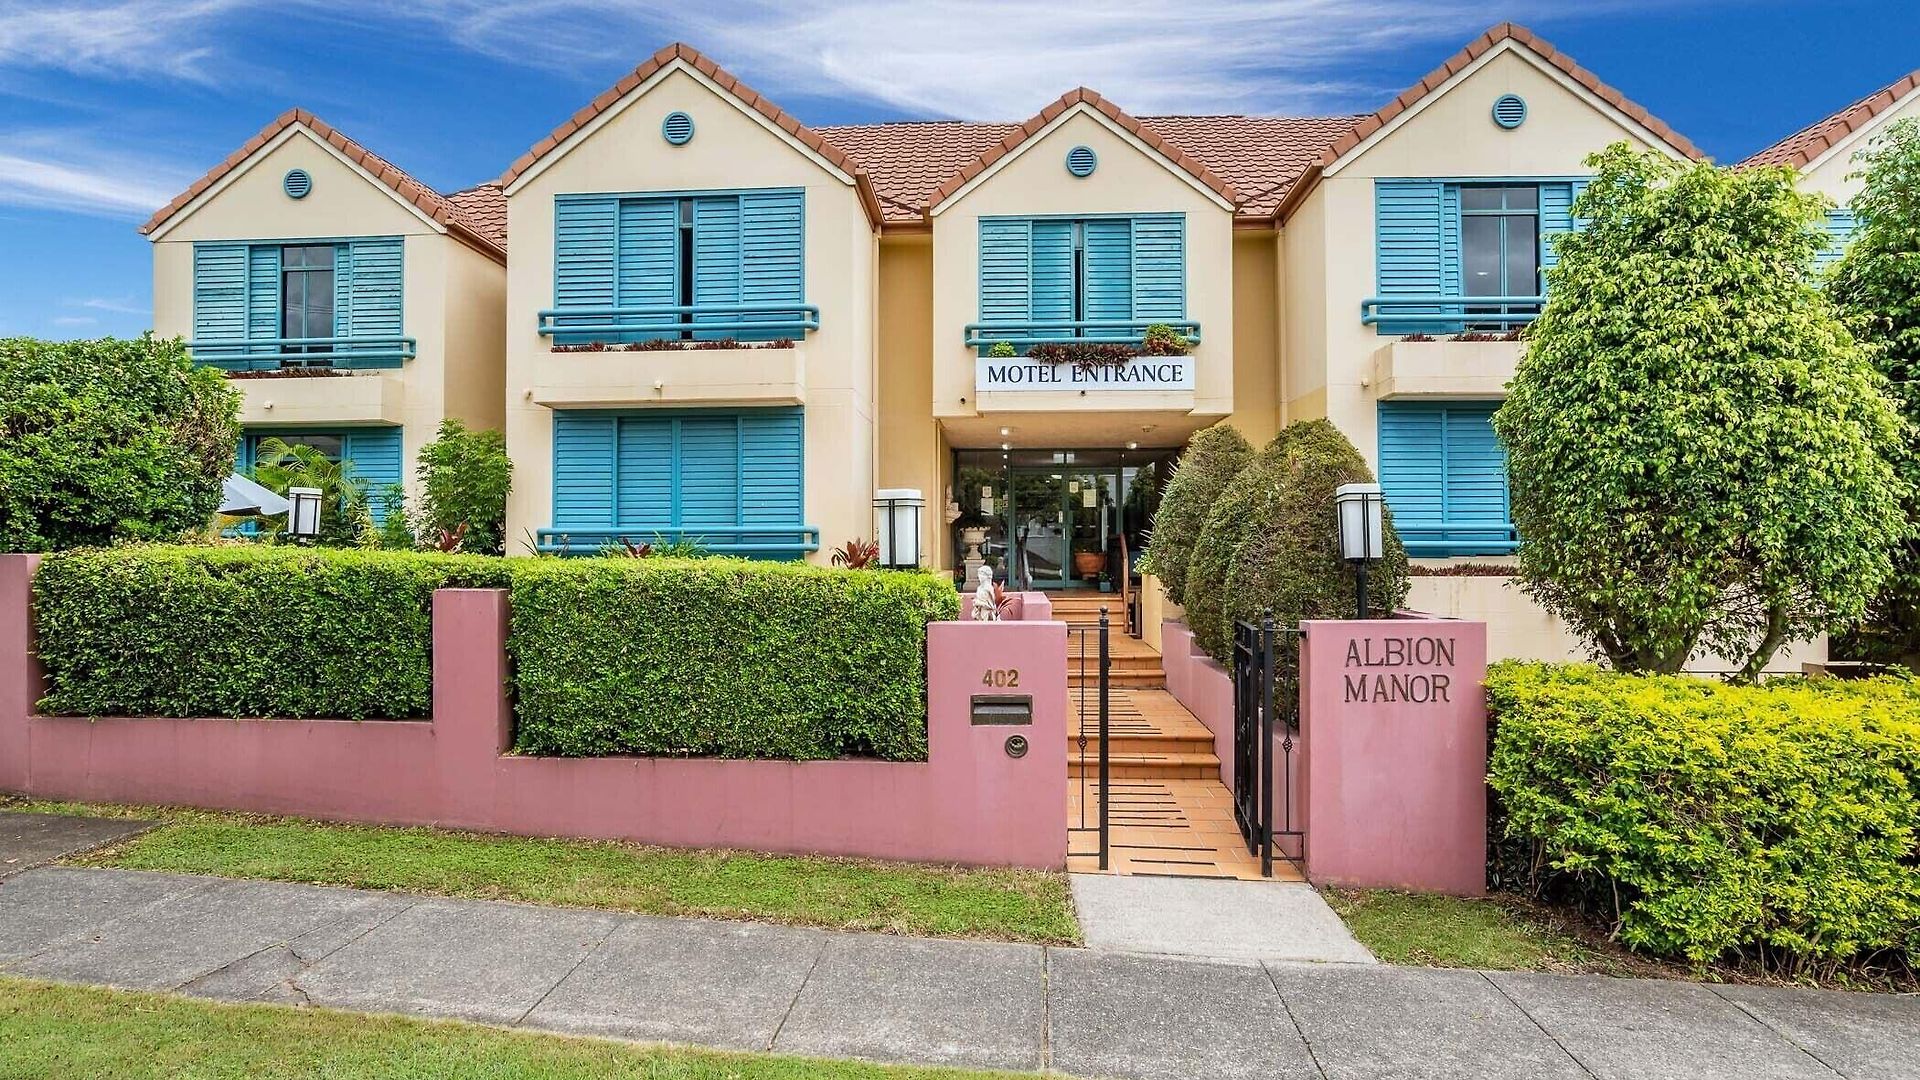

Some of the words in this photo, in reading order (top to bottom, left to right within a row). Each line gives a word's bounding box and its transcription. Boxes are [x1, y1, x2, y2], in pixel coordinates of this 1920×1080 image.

[988, 365, 1061, 383] MOTEL
[1072, 364, 1183, 383] ENTRANCE
[1345, 637, 1456, 667] ALBION
[982, 669, 1019, 687] 402
[1344, 674, 1451, 703] MANOR
